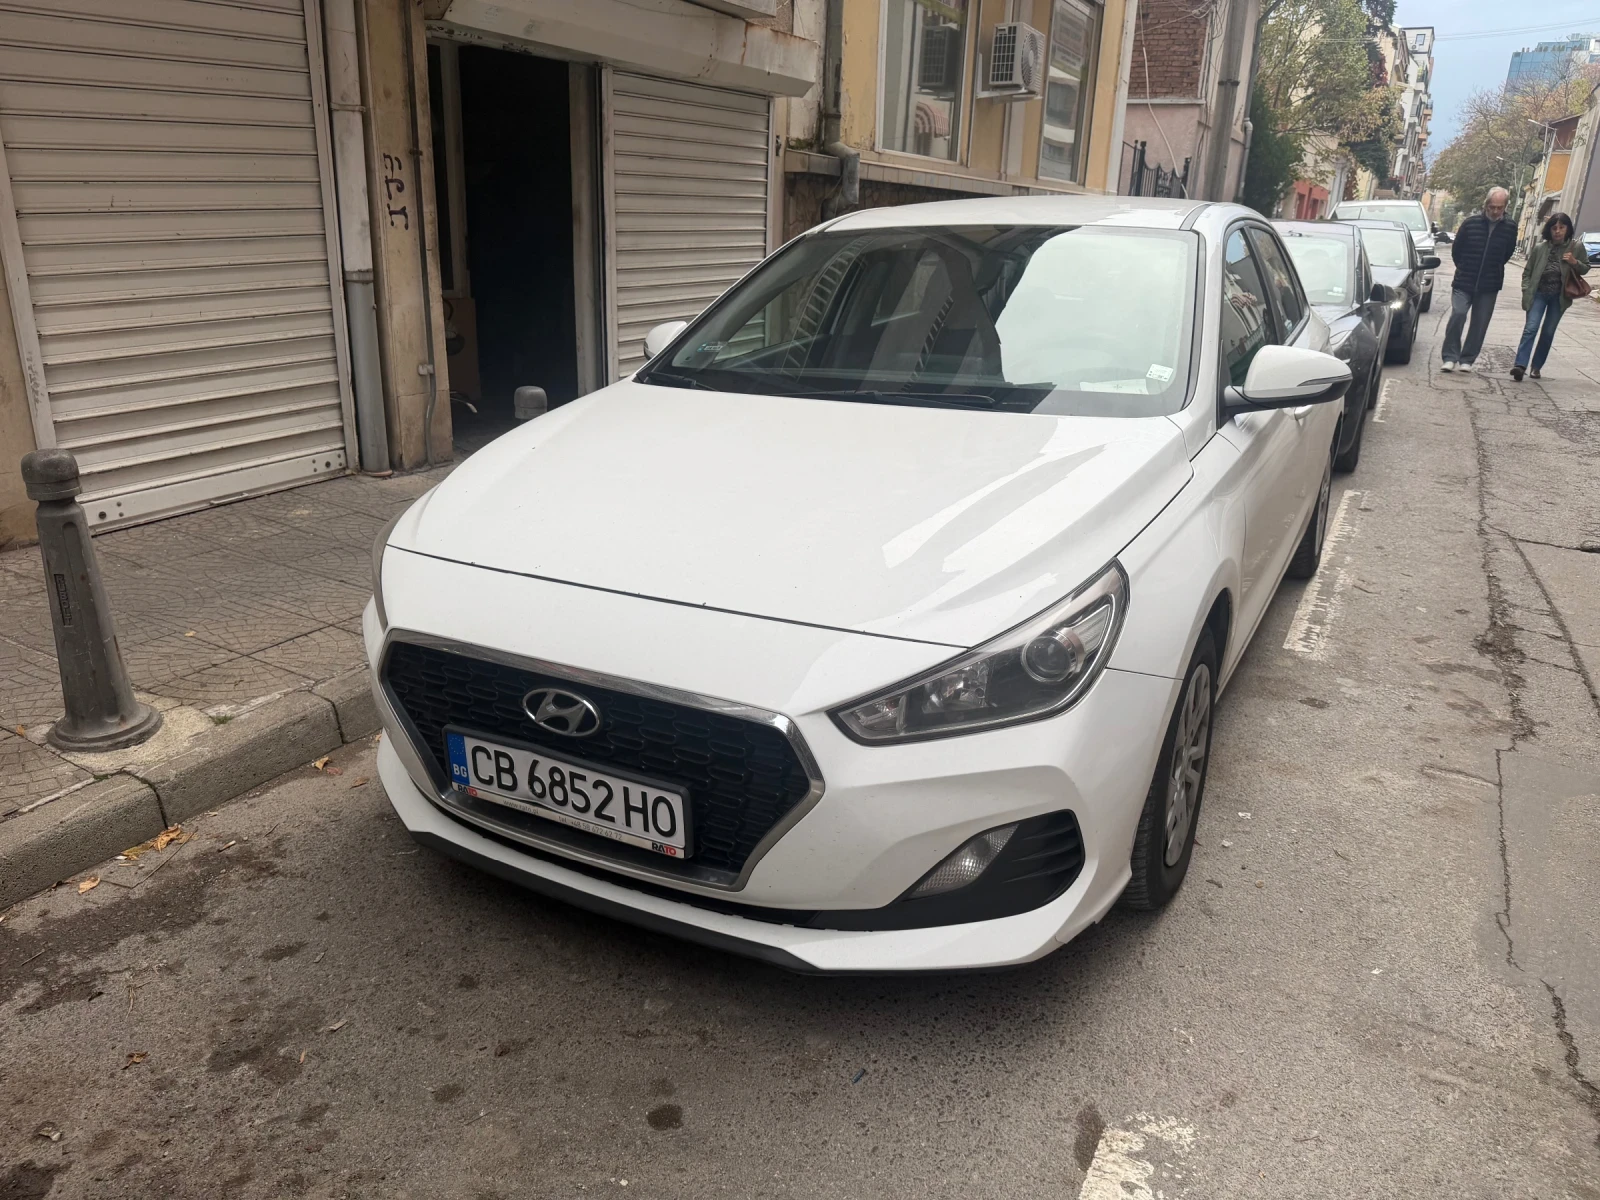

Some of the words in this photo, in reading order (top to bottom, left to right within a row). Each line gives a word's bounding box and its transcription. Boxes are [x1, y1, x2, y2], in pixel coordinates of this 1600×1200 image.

[453, 764, 468, 778] BG
[471, 745, 518, 791] CB
[528, 759, 616, 823] 6852
[623, 786, 677, 838] HO
[458, 784, 477, 797] RATO
[651, 842, 677, 856] RATO
